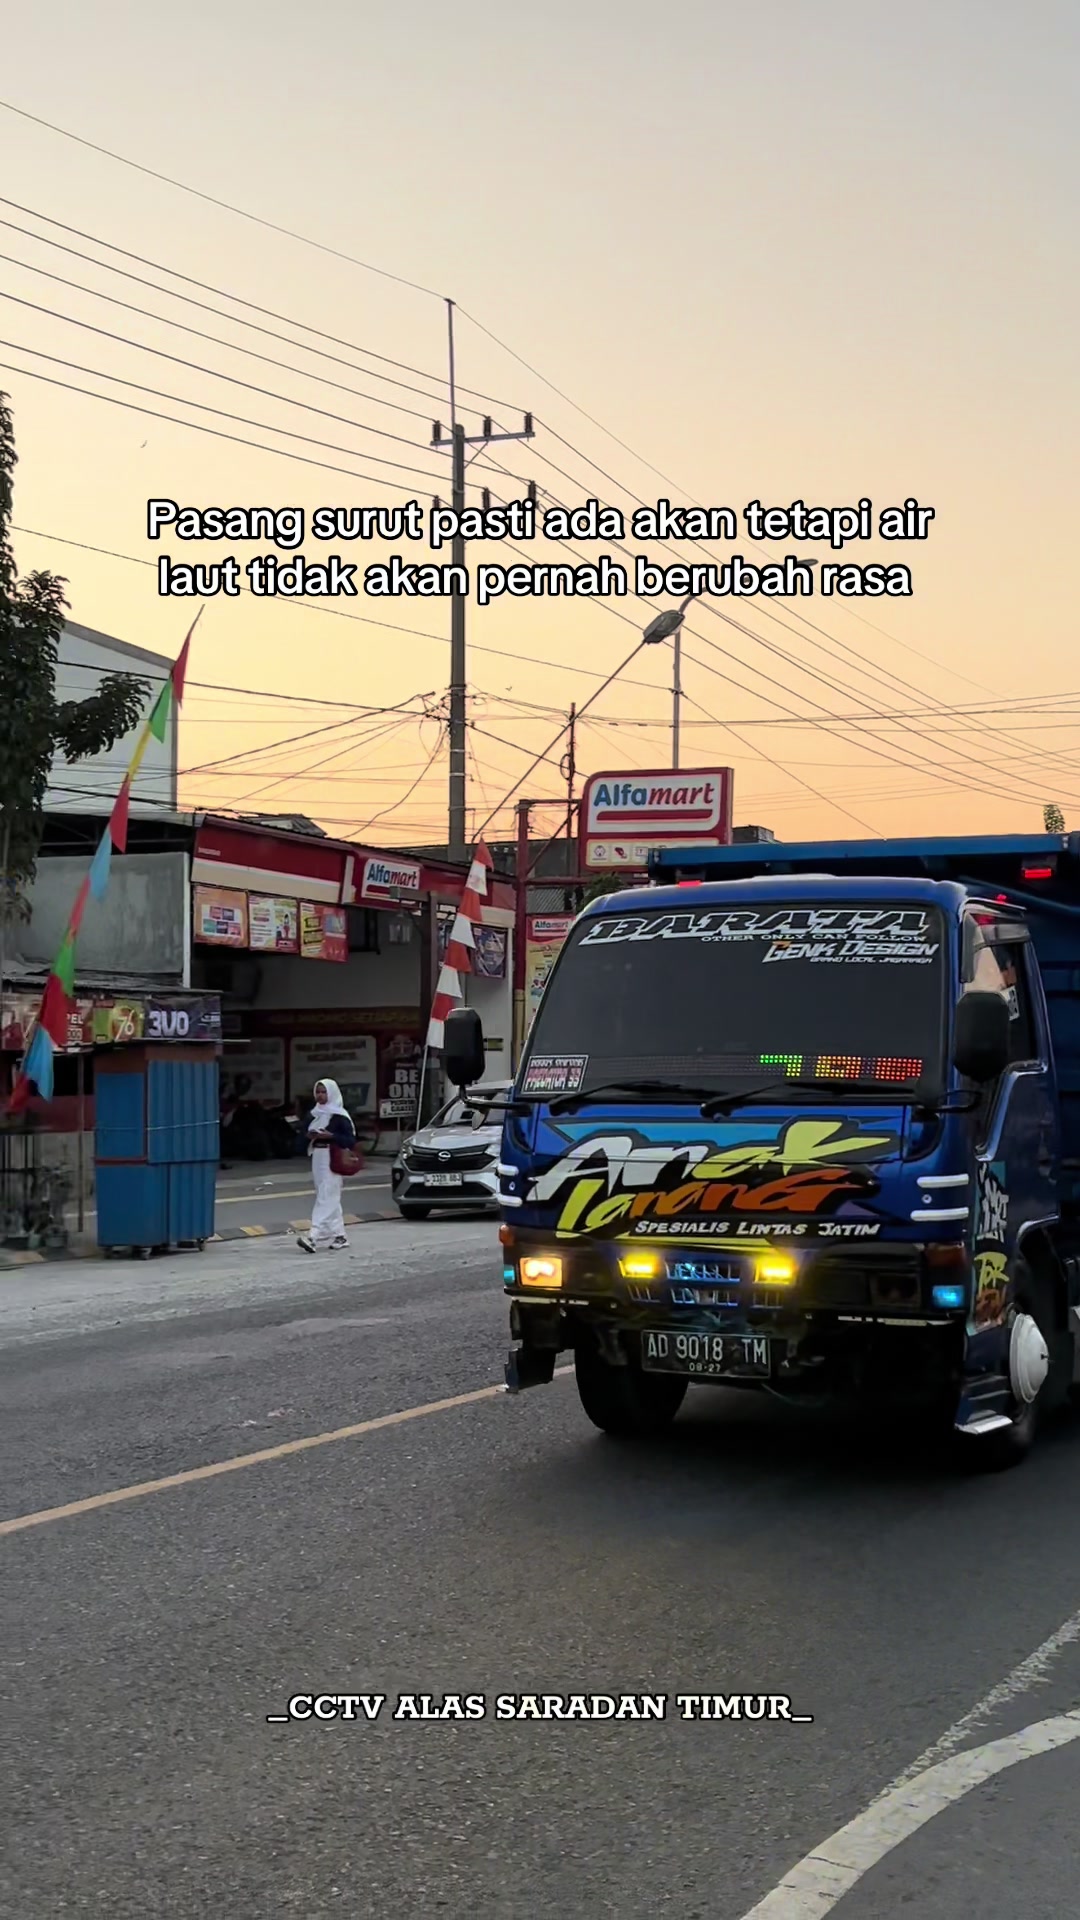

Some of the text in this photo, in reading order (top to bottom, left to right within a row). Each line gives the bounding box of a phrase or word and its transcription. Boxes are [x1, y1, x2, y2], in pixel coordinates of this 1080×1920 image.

[593, 783, 715, 807] Alfamart
[367, 863, 418, 887] Alfamart
[577, 910, 930, 946] BARATA
[701, 933, 928, 943] OTHER ONLY CAN FOLLOW
[839, 940, 940, 956] DESIGN
[635, 1220, 881, 1236] SPESIALIS LINTAS JATIM
[647, 1333, 767, 1365] AD 9018 TM
